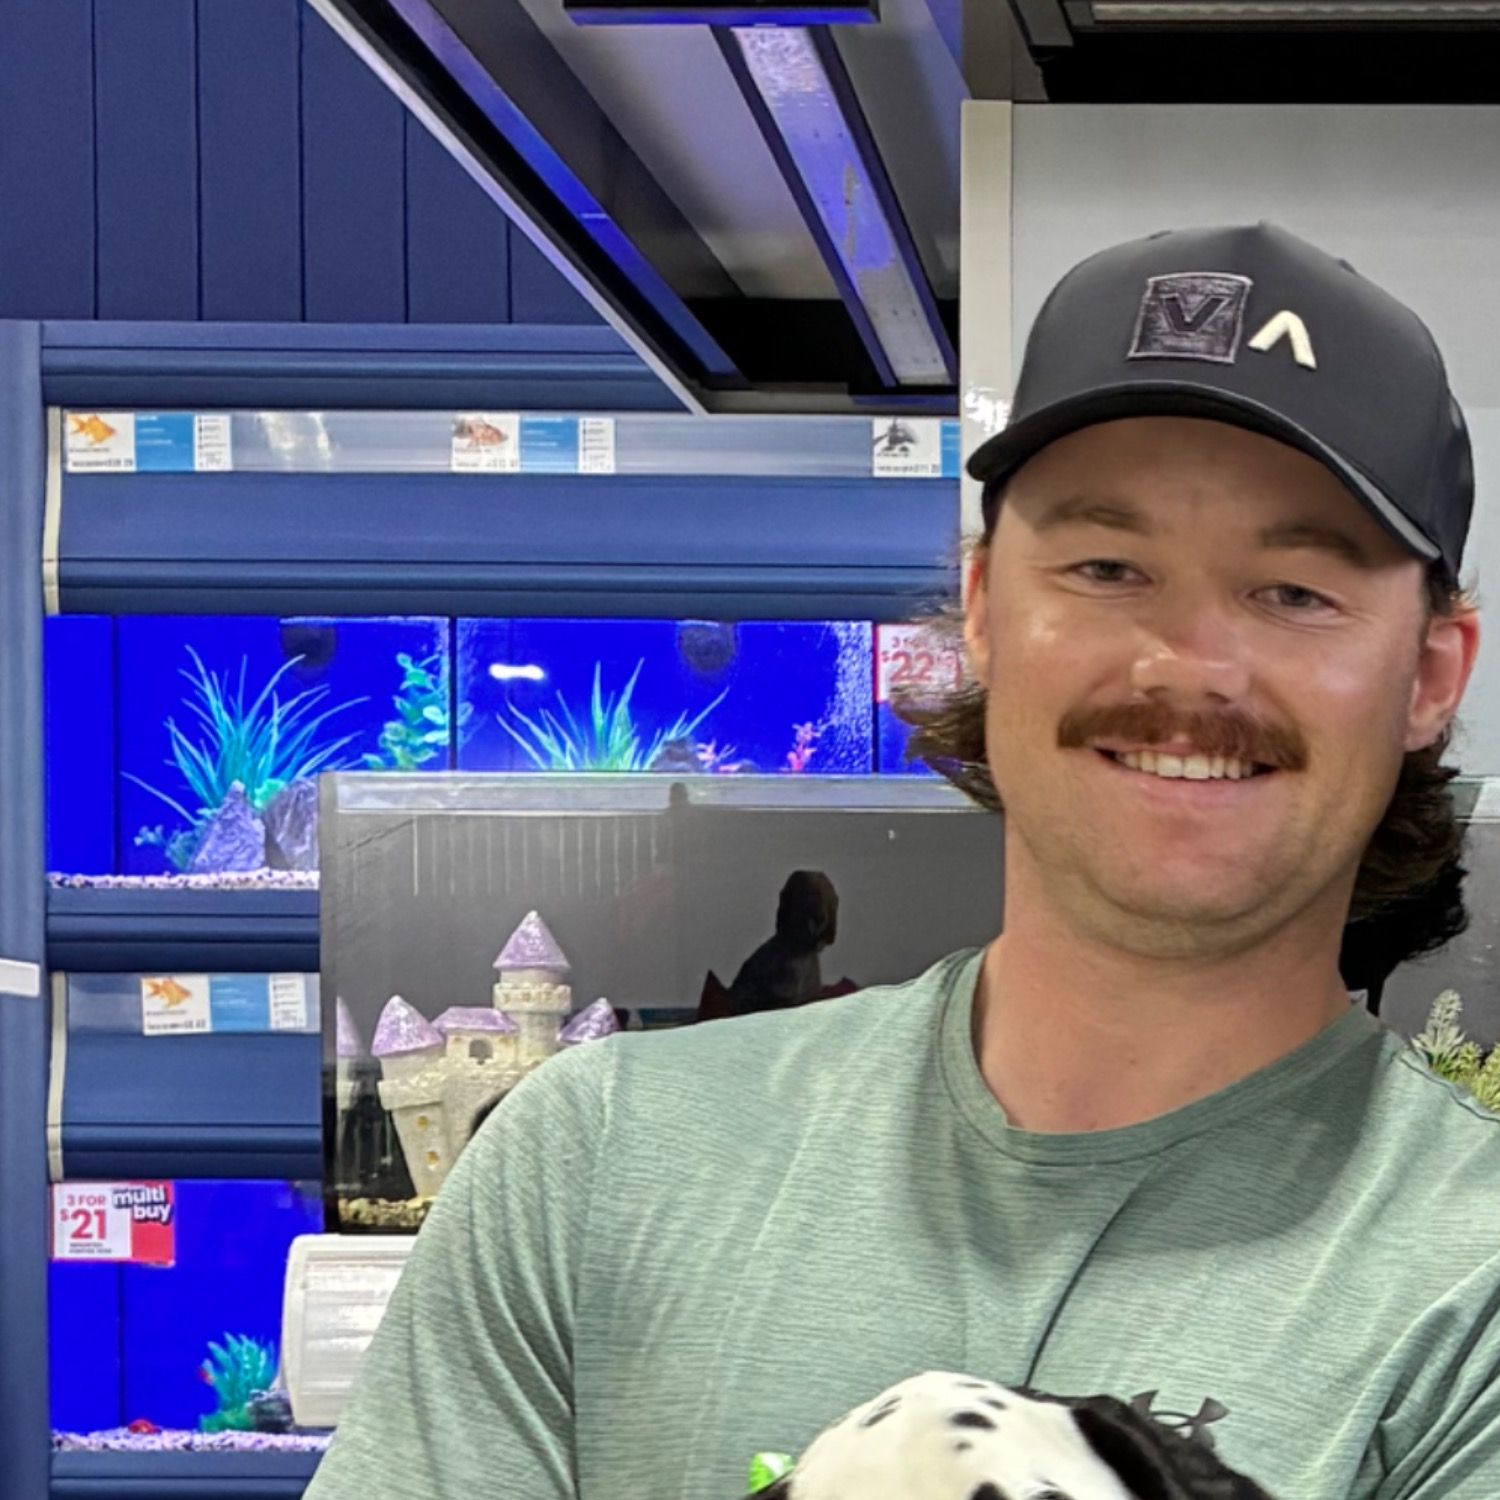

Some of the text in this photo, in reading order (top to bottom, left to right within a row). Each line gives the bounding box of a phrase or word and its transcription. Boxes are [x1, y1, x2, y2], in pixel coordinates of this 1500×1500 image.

[66, 1194, 106, 1207] 3 FOR
[112, 1183, 166, 1206] multi
[133, 1203, 171, 1223] buy
[60, 1208, 107, 1240] $21
